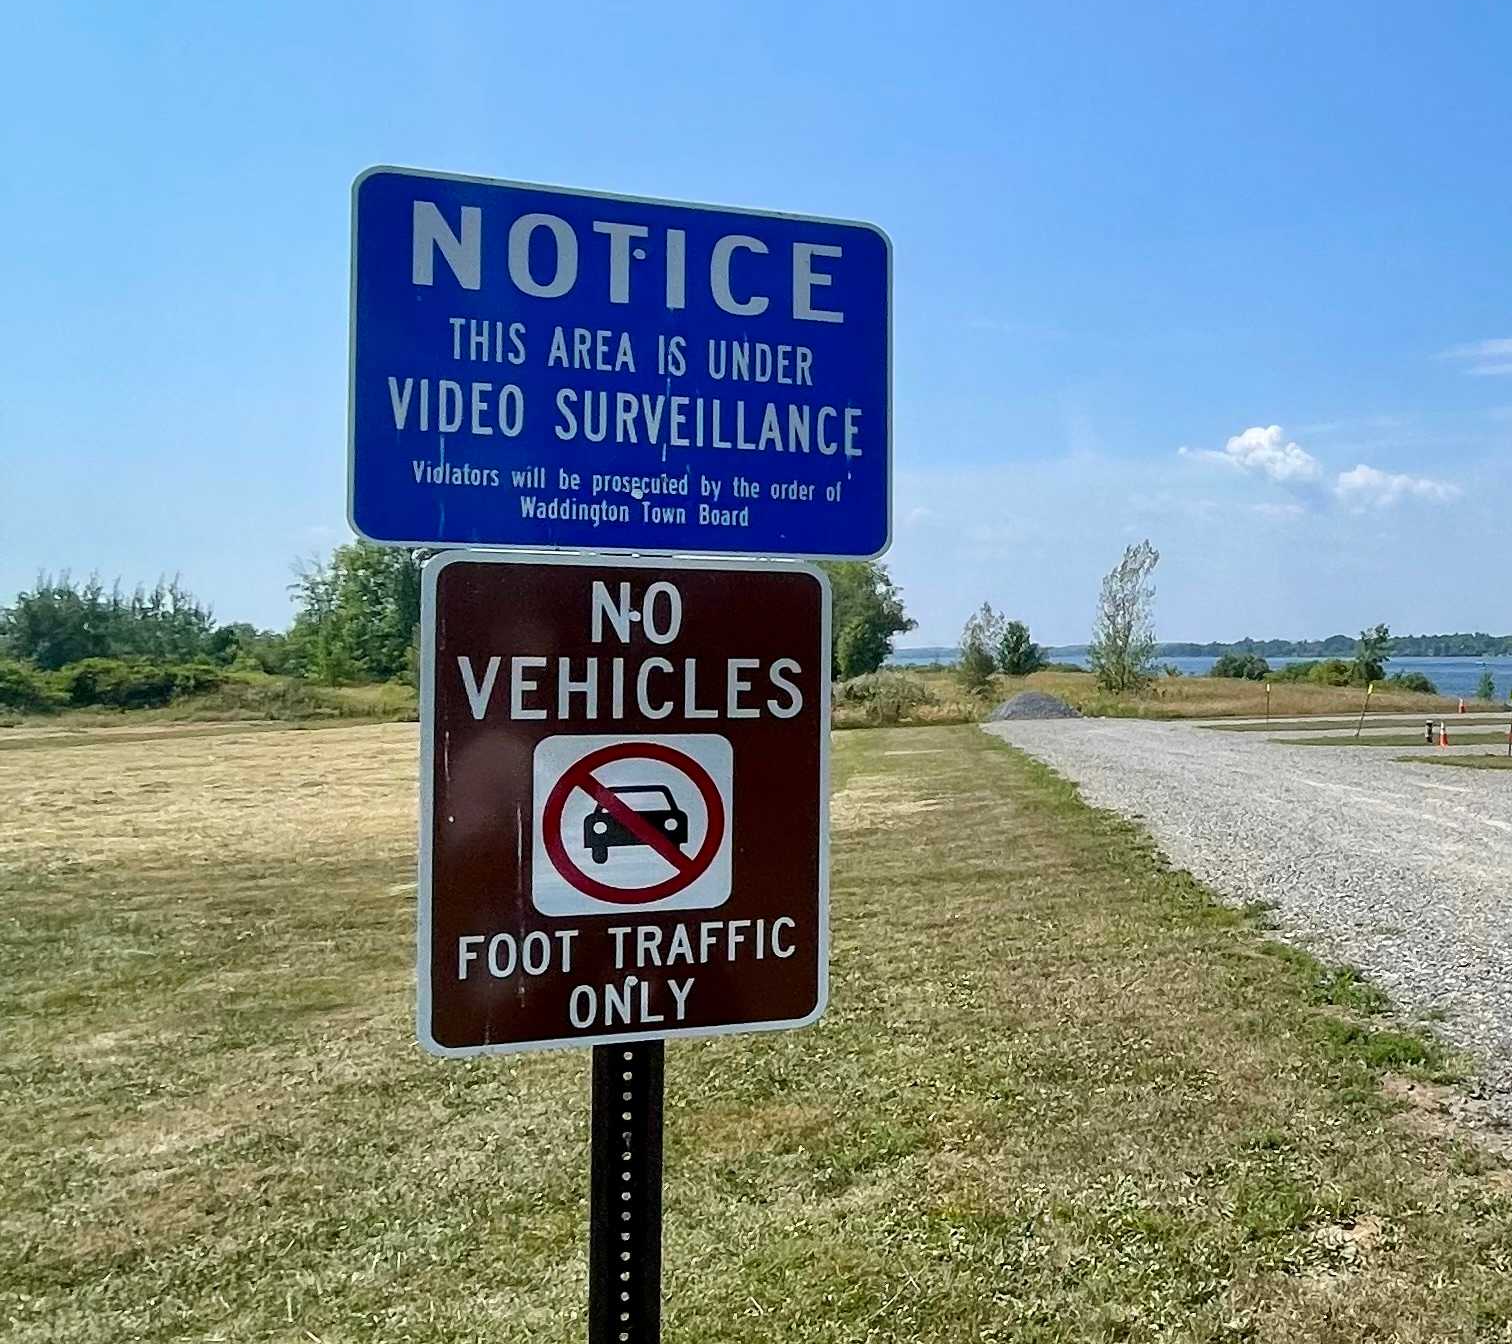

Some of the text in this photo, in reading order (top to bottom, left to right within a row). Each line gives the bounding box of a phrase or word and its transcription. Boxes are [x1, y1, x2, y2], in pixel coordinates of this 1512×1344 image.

[412, 200, 845, 324] NOTICE
[449, 318, 814, 387] THIS AREA IS UNDER
[388, 376, 863, 457] VIDEO SURVEILLANCE
[413, 460, 842, 502] Violators will be prosecuted by the order of
[520, 496, 750, 527] Waddington Town Board
[591, 581, 682, 644] NO
[457, 656, 804, 720] VEHICLES
[457, 917, 797, 980] FOOT TRAFFIC
[569, 977, 695, 1029] ONLY
